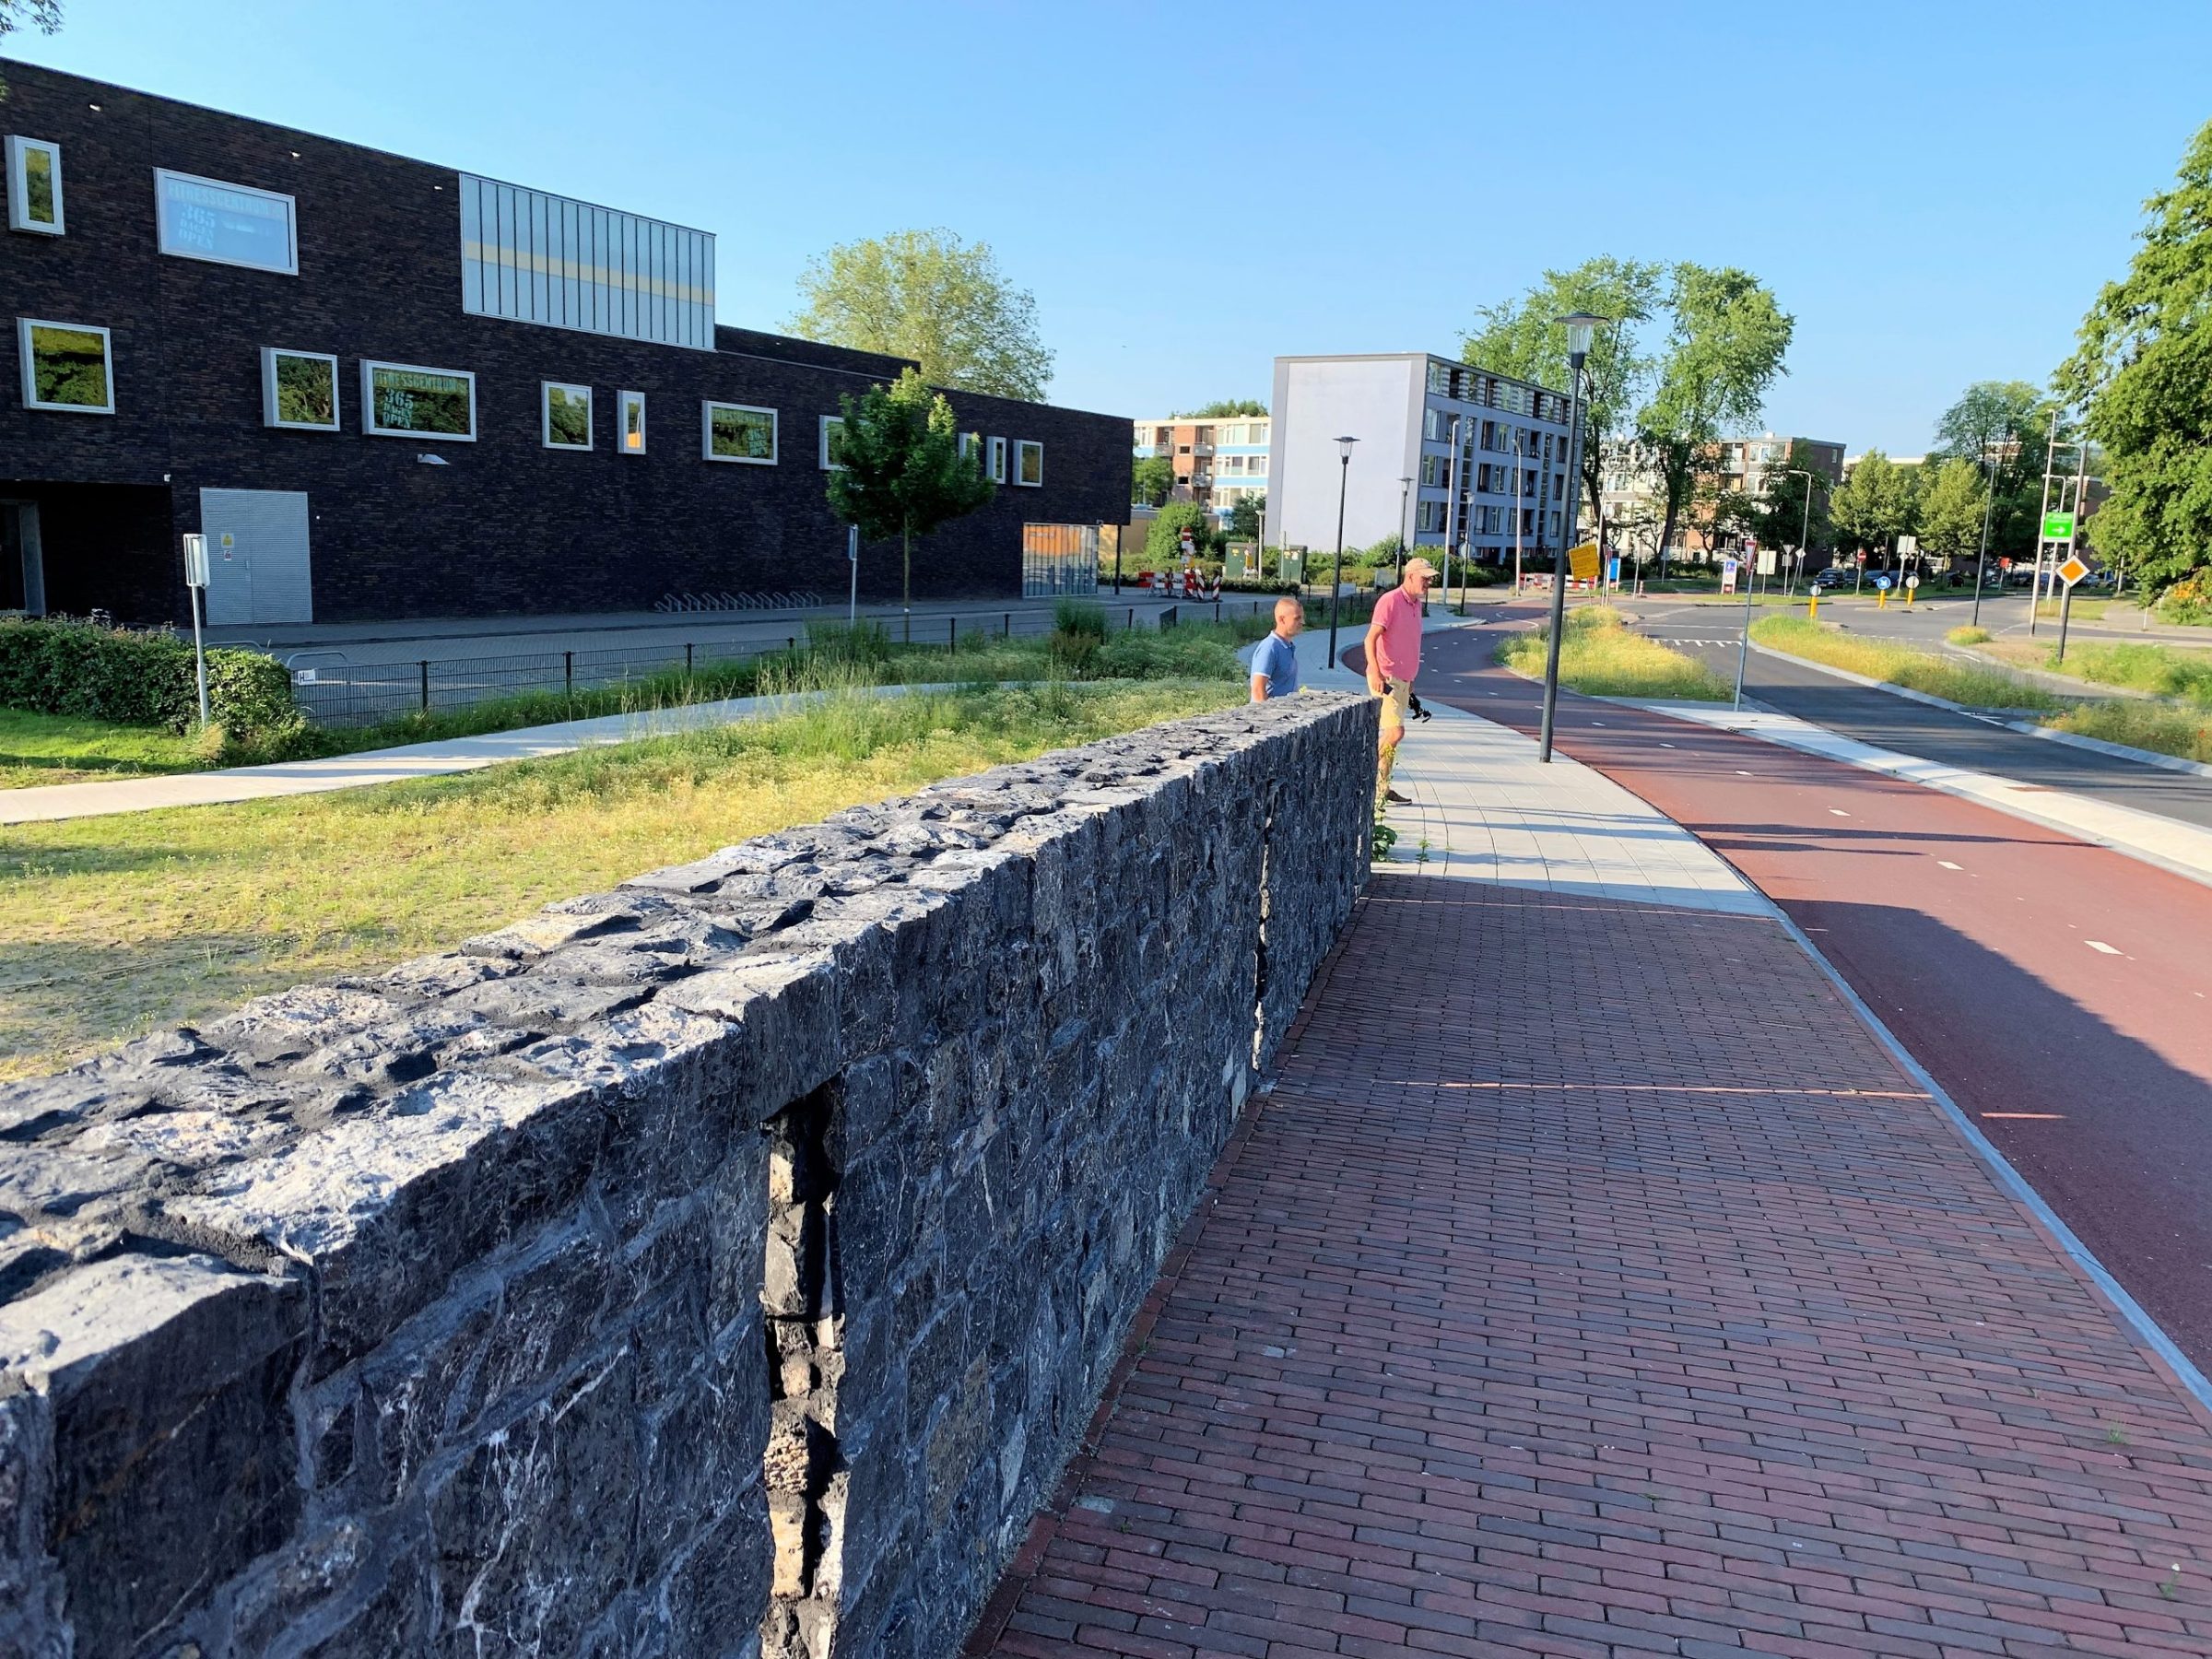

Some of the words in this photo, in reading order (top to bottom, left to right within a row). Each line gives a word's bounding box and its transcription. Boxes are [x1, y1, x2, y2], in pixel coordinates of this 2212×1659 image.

[181, 202, 216, 229] 365
[178, 228, 215, 250] OPEN
[384, 387, 414, 409] 365
[382, 411, 412, 429] OPEN
